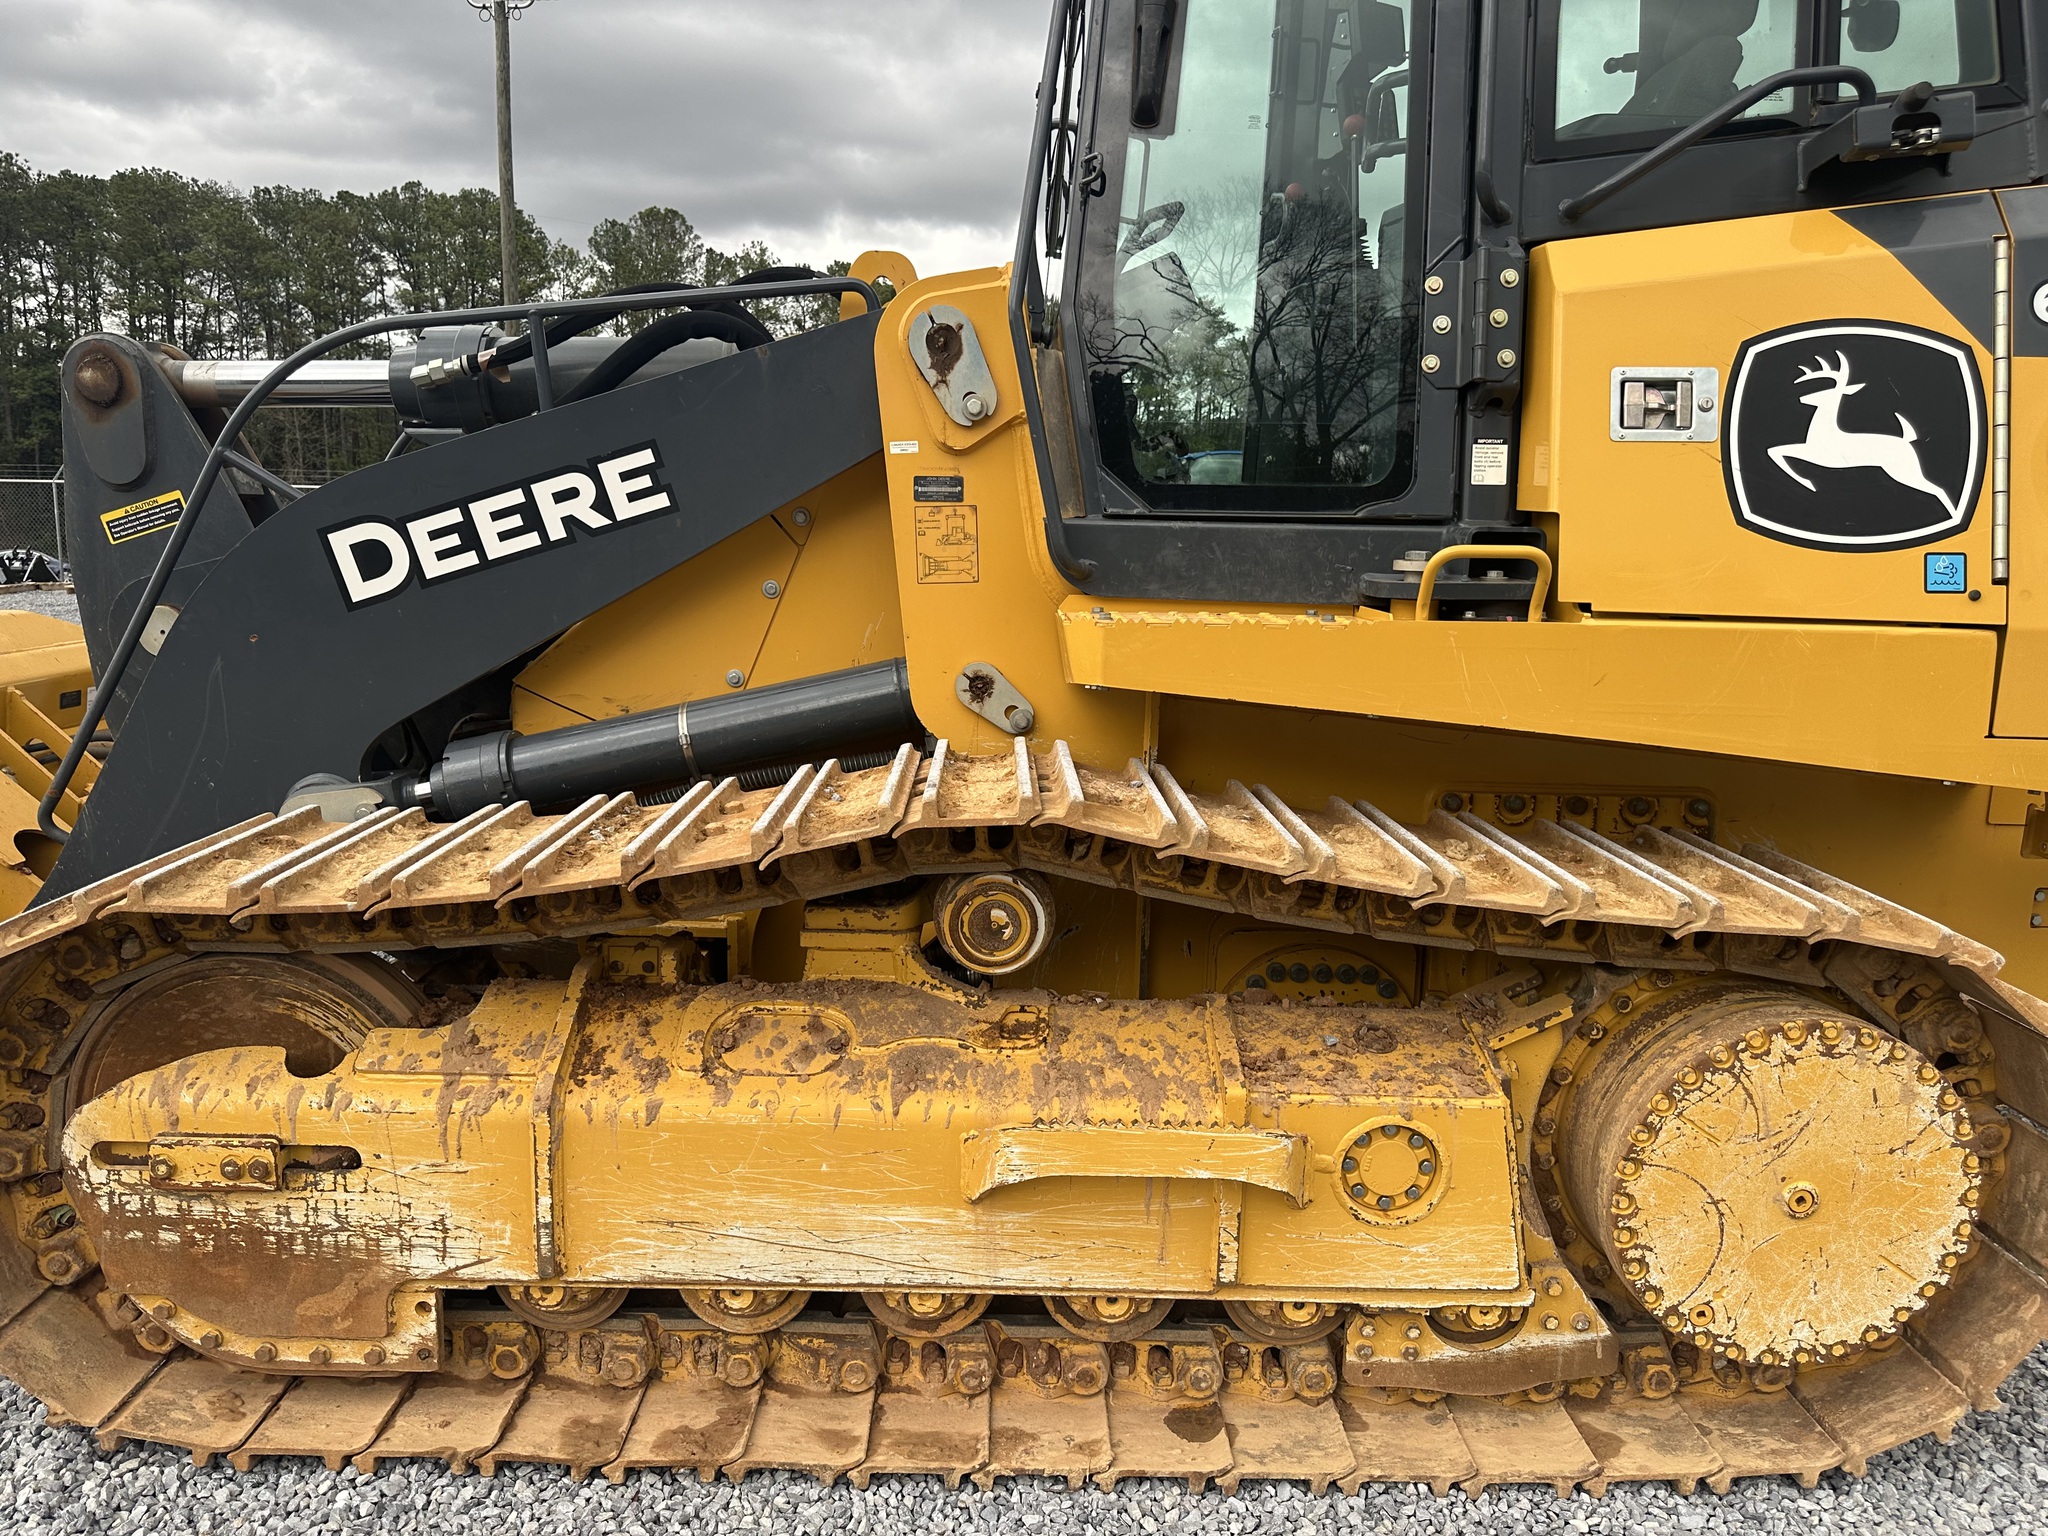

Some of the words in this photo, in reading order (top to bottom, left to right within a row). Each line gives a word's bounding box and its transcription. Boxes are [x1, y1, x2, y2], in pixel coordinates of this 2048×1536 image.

[130, 498, 159, 512] CAUTION
[161, 502, 178, 510] movement.
[111, 525, 125, 533] Support
[326, 448, 671, 603] DEERE
[120, 528, 137, 536] Operator's
